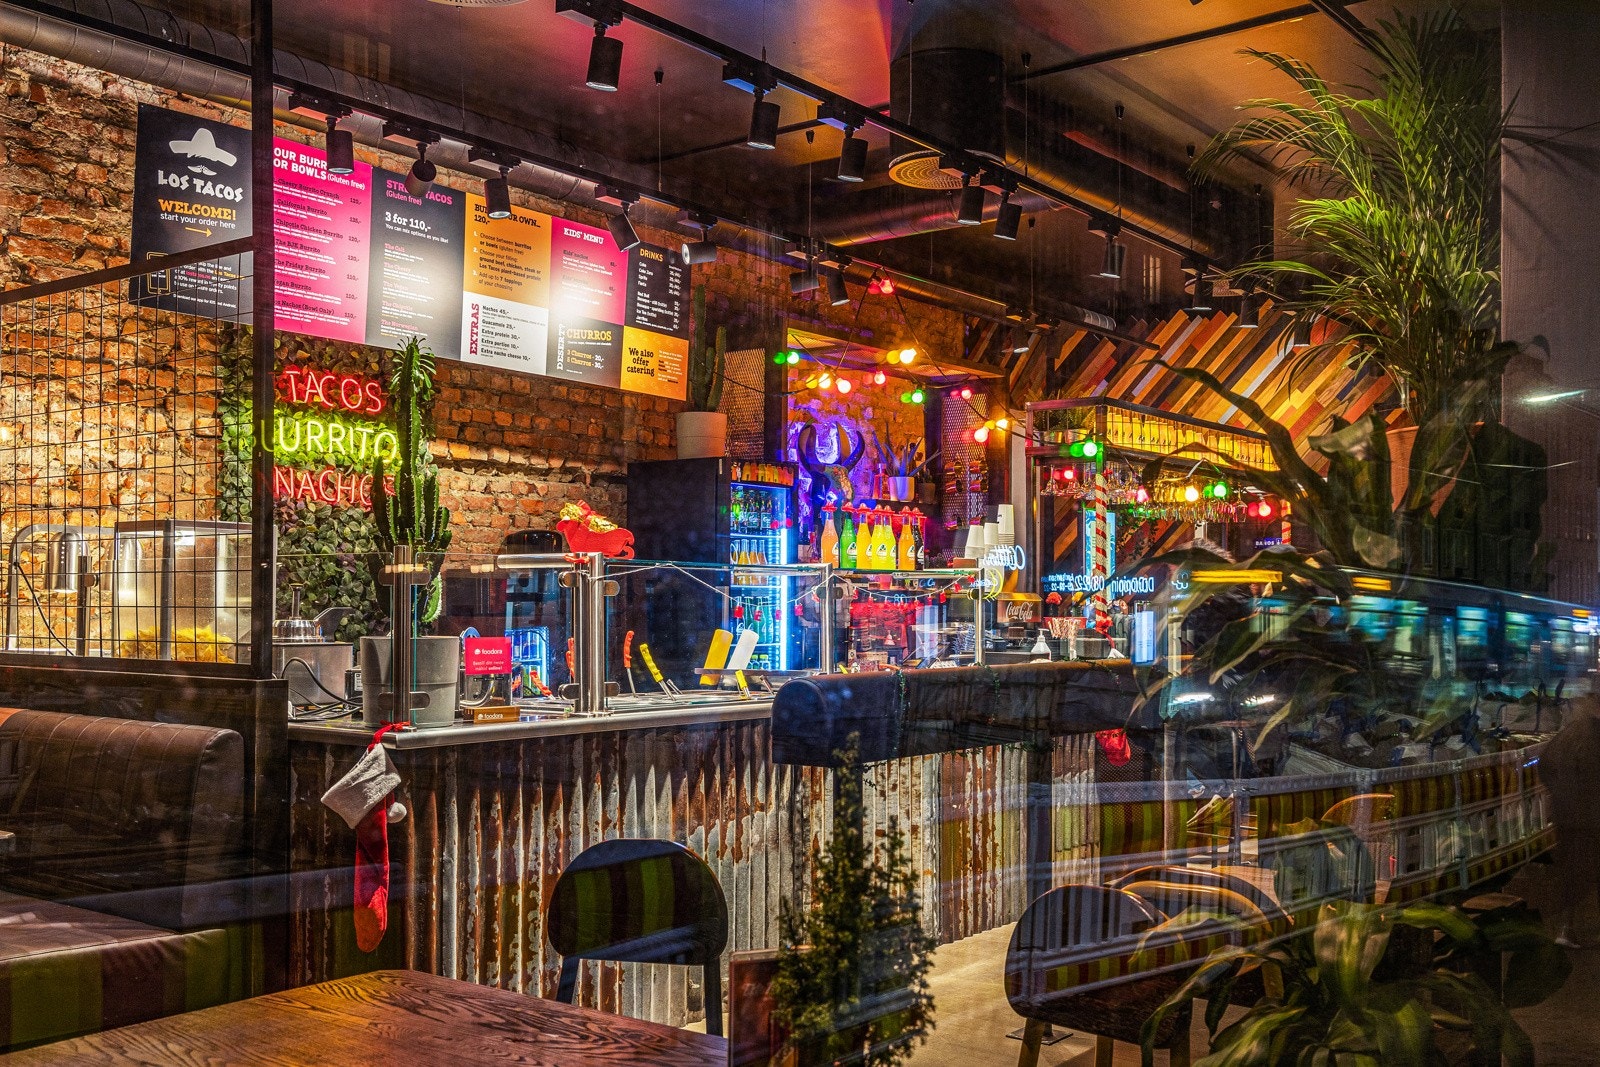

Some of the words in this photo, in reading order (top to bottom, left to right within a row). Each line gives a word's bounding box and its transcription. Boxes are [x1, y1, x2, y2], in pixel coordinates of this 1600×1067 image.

[274, 148, 296, 162] OUR
[300, 154, 328, 171] BURR
[274, 159, 288, 171] OR
[292, 163, 327, 181] BOWLS
[328, 174, 350, 186] (Gluten
[351, 180, 366, 191] free)
[158, 170, 189, 190] LOS
[194, 178, 244, 202] TACOS
[386, 179, 409, 194] STR
[386, 190, 408, 202] (Gluten
[409, 196, 423, 206] free)
[158, 199, 236, 220] WELCOME!
[307, 206, 328, 216] Burrito
[161, 213, 179, 221] start
[180, 216, 197, 224] your
[199, 218, 218, 227] order
[220, 220, 236, 229] here
[386, 212, 392, 222] 3
[393, 214, 408, 226] for
[409, 218, 431, 232] 110,-
[475, 215, 490, 225] 120,-
[301, 223, 323, 234] Chicken
[323, 230, 344, 240] Burrito
[564, 227, 583, 239] KIDS'
[583, 232, 605, 245] MENU
[480, 233, 496, 242] Choose
[515, 241, 532, 250] burritos
[300, 244, 321, 253] Burrito
[480, 249, 496, 257] Choose
[480, 257, 495, 265] ground
[640, 249, 664, 262] DRINKS
[305, 265, 326, 274] Burrito
[291, 282, 312, 291] Burrito
[504, 278, 523, 287] toppings
[483, 305, 499, 313] Nachos
[482, 319, 505, 328] Guacamole
[470, 303, 480, 356] EXTRAS
[495, 331, 510, 339] protein
[567, 329, 612, 342] CHURROS
[494, 340, 510, 348] portion
[507, 352, 522, 360] cheese
[571, 350, 592, 360] Churros
[629, 347, 639, 357] We
[640, 350, 654, 358] also
[571, 358, 592, 367] Churros
[633, 357, 650, 367] offer
[627, 366, 655, 378] catering
[285, 370, 382, 412] TACOS
[279, 417, 397, 463] URRITO
